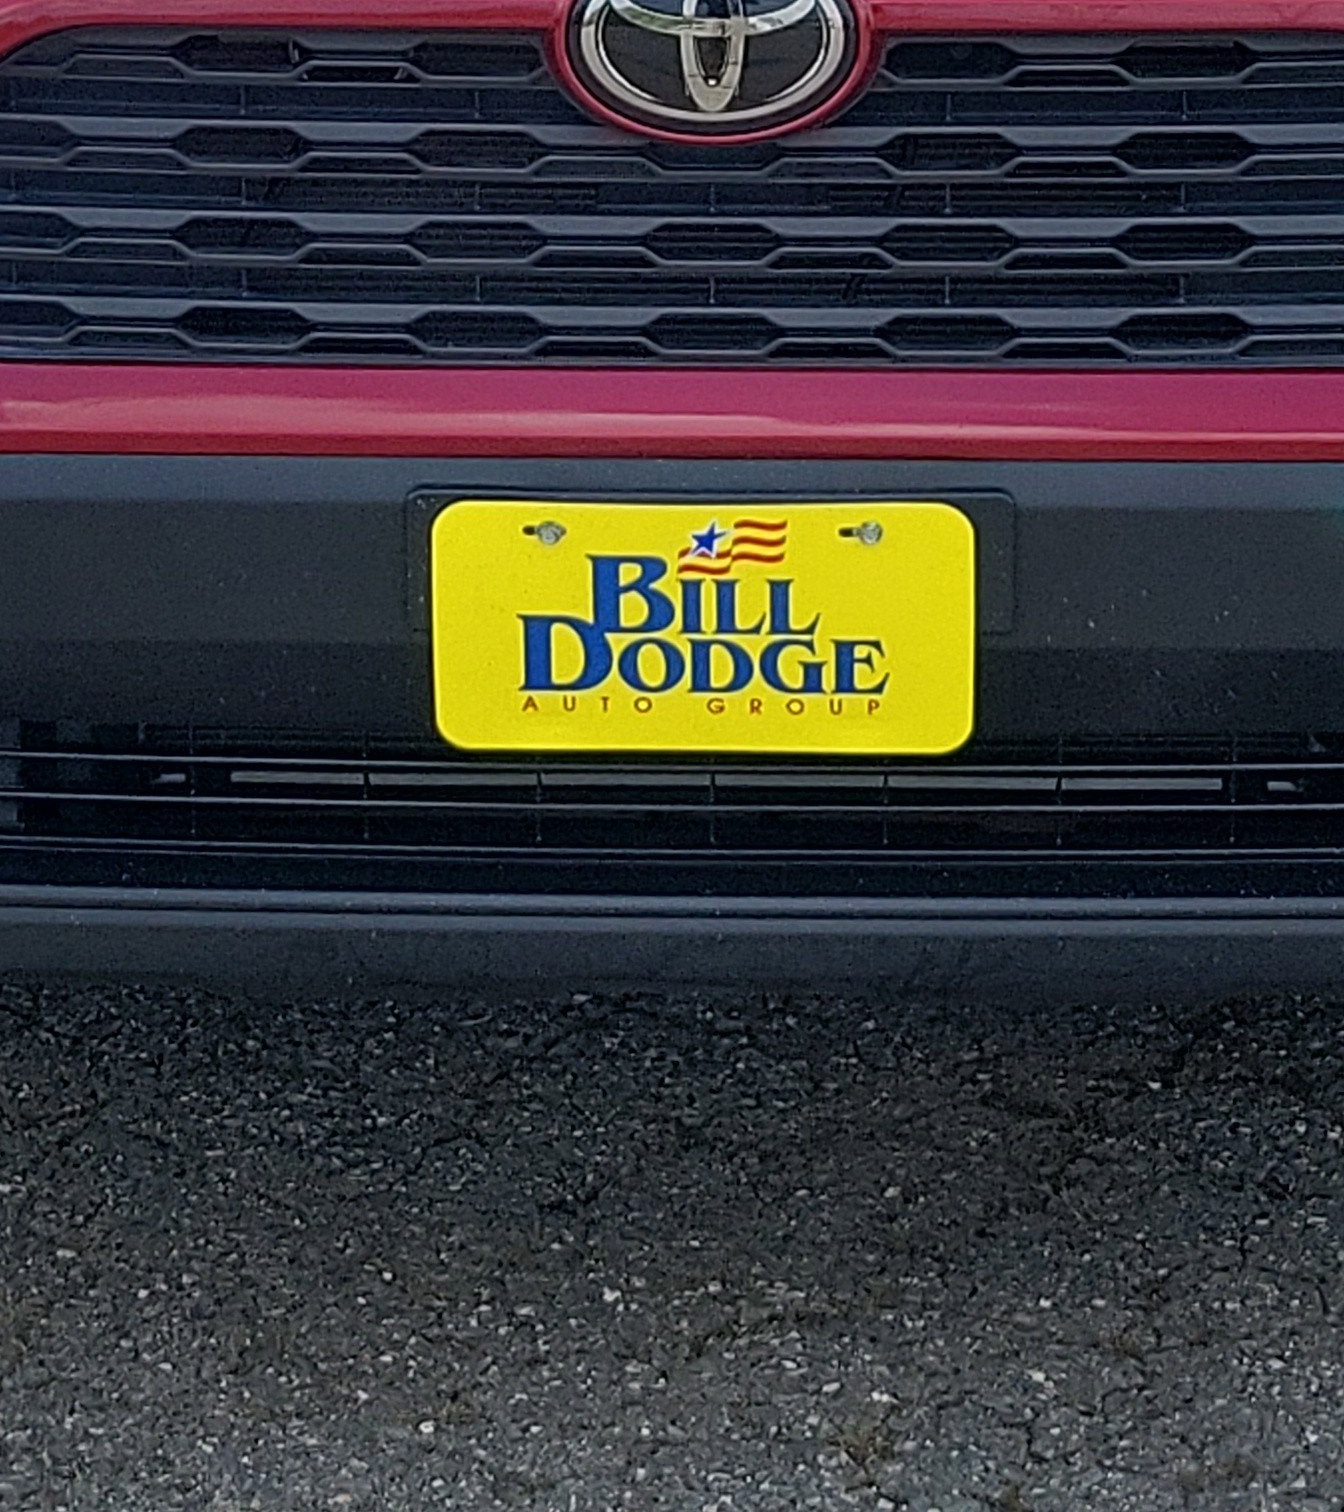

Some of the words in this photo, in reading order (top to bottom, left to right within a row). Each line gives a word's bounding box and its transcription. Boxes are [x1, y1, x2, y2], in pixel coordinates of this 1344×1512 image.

[586, 553, 822, 635] BILL
[517, 613, 891, 695] DODGE
[522, 695, 653, 715] AUTO
[706, 696, 881, 716] GROUP
